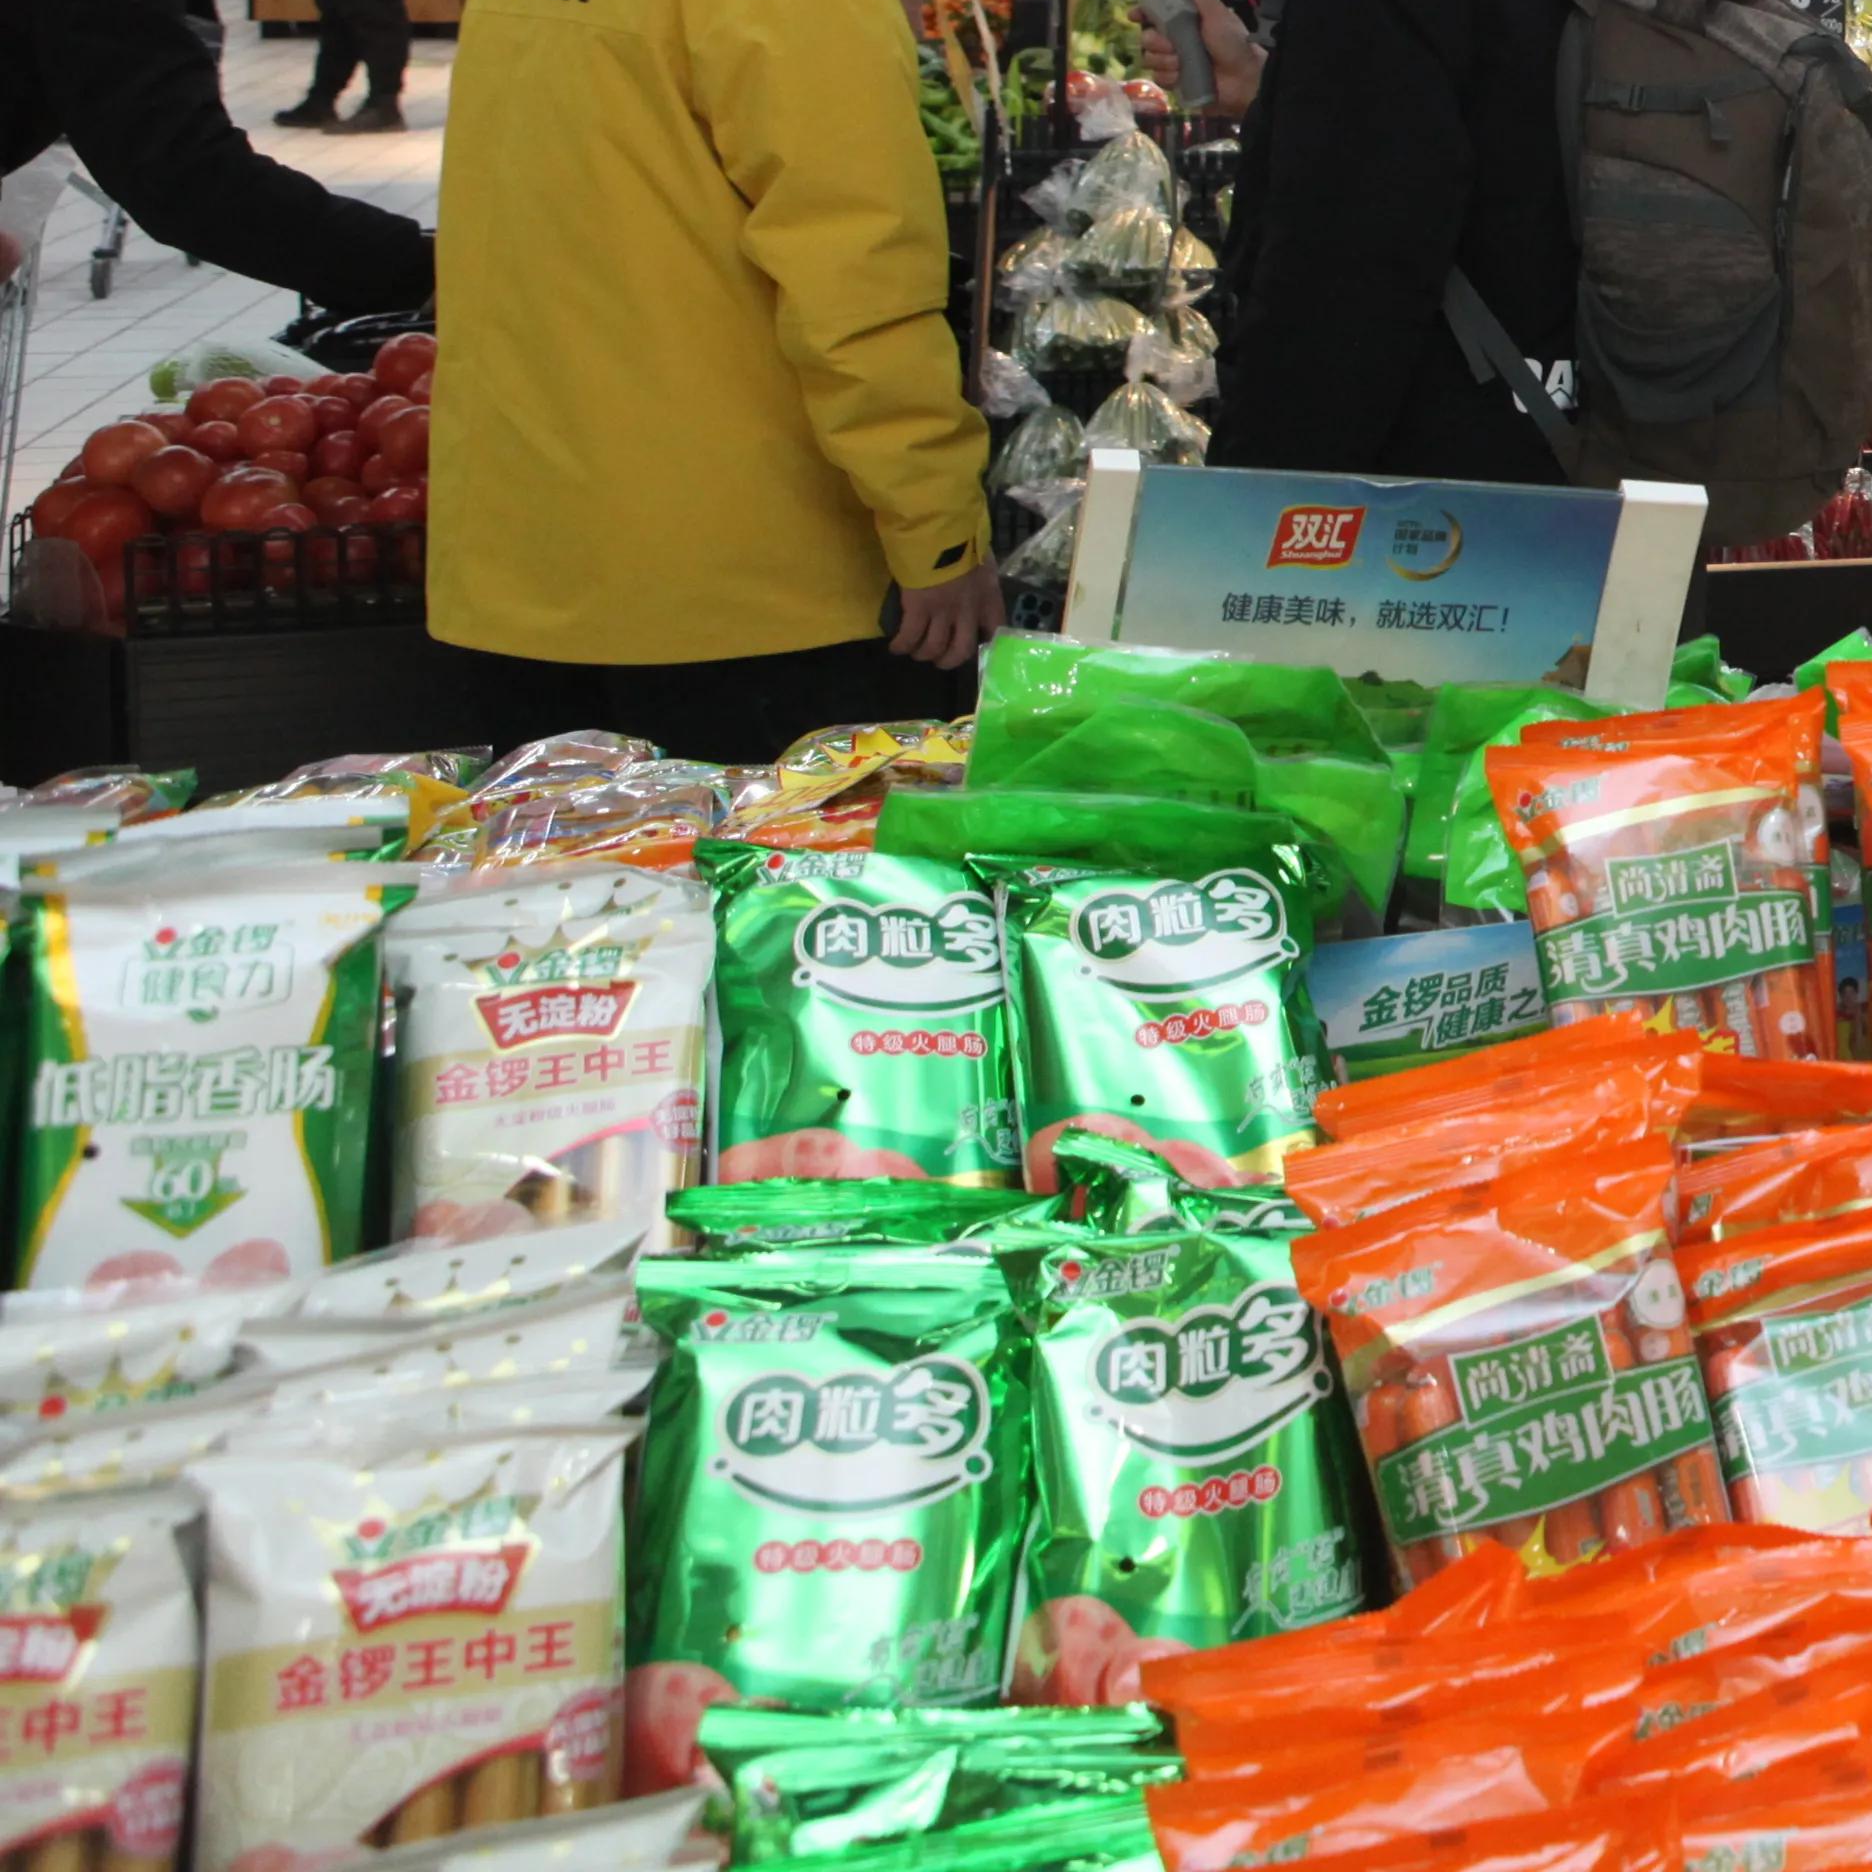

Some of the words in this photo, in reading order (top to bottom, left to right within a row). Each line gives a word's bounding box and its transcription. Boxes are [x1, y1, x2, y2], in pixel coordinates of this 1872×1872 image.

[1279, 548, 1343, 561] Shuanghui
[1280, 513, 1355, 550] 双汇
[1615, 855, 1731, 913] 尚清斋
[186, 923, 280, 955] 金锣
[815, 902, 1001, 972] 肉粒多
[1086, 881, 1274, 954] 肉粒多
[1546, 891, 1807, 995] 清真鸡肉肠
[139, 962, 278, 1006] 健食力
[531, 947, 623, 981] 金锣
[1360, 960, 1510, 1031] 金锣品质
[500, 992, 617, 1044] 无淀粉
[853, 1032, 987, 1058] 特级火腿肠
[1137, 1001, 1269, 1047] 特级火腿肠
[34, 1044, 337, 1128] 低脂香肠
[435, 1040, 674, 1104] 金锣王中王
[1108, 1300, 1319, 1396] 肉粒多
[1465, 1326, 1598, 1411] 尚清斋
[737, 1362, 972, 1459] 肉粒多
[1398, 1361, 1708, 1526] 清真鸡肉肠
[1141, 1470, 1281, 1514] 特级火腿肠
[756, 1539, 921, 1573] 特级火腿肠
[275, 1621, 577, 1713] 金锣王中王
[0, 1690, 147, 1762] 中王
